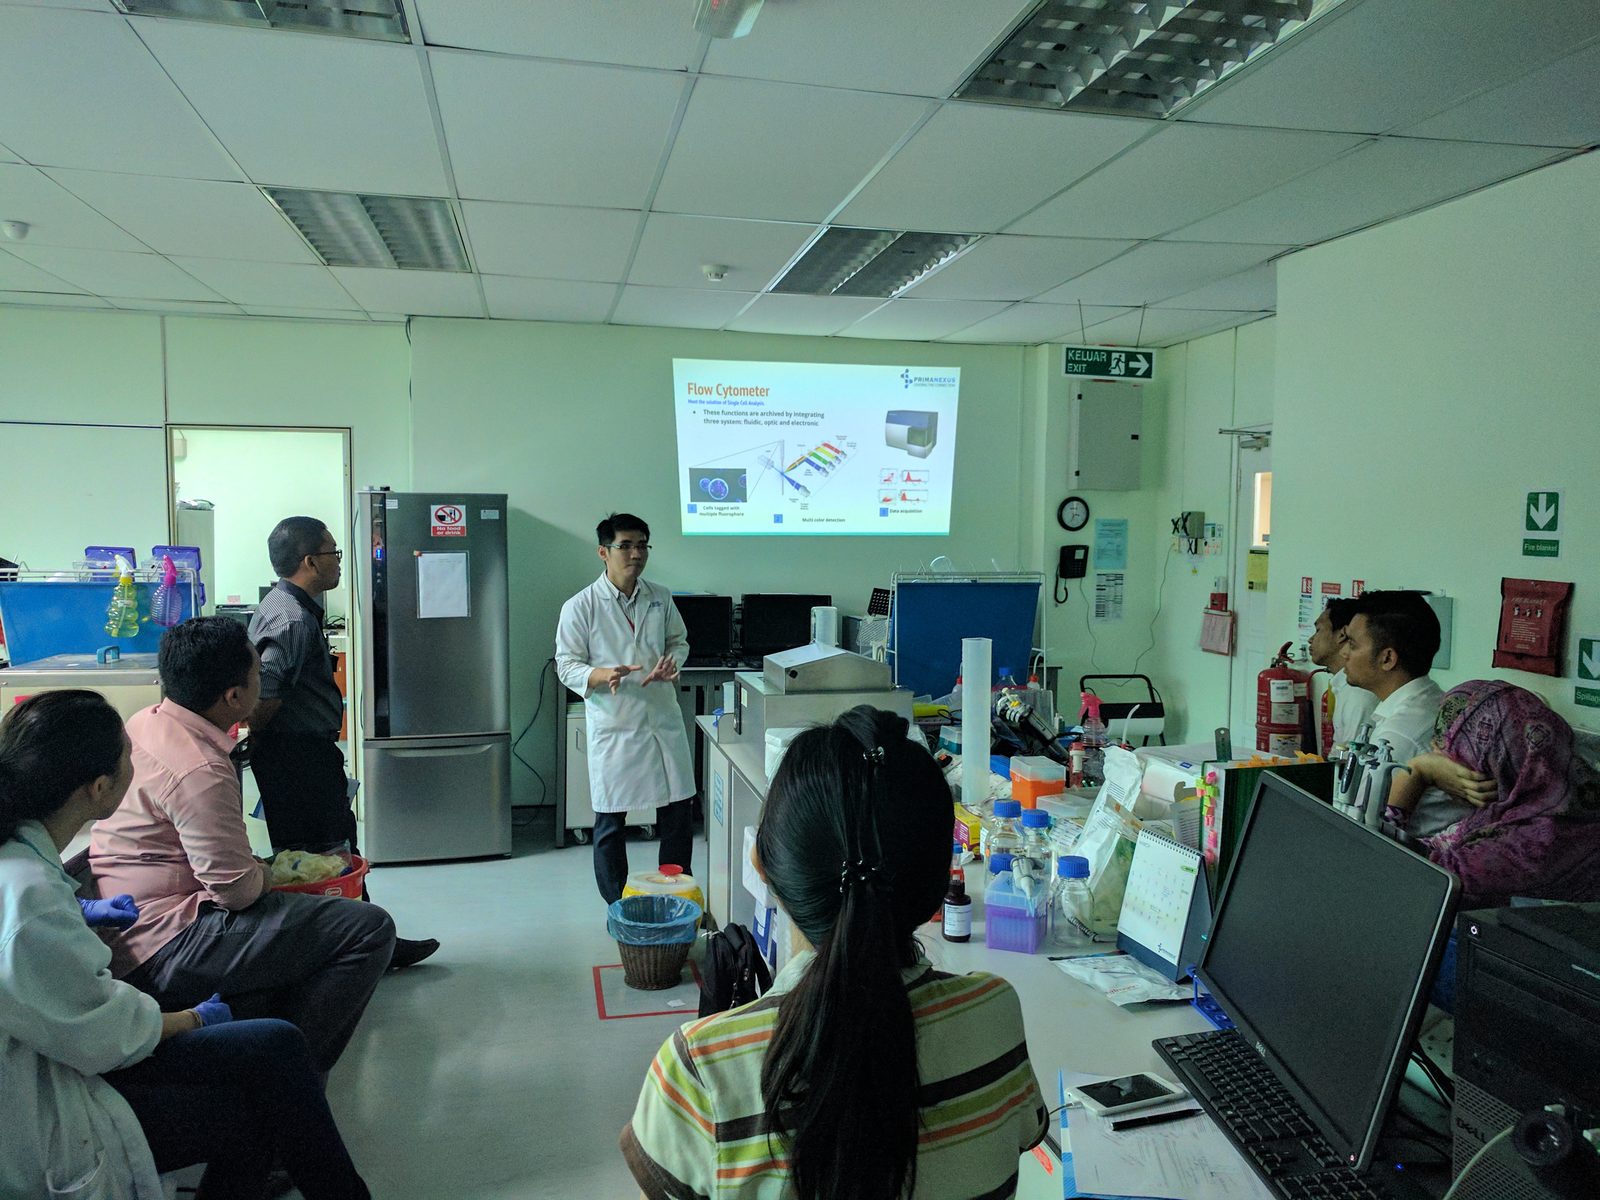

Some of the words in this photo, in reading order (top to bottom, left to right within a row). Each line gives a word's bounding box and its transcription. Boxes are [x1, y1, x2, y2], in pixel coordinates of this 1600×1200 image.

[1068, 350, 1107, 362] KELUAR
[1067, 363, 1087, 373] EXIT
[687, 382, 713, 396] Flow
[716, 383, 770, 399] Cytometer
[721, 409, 748, 417] functions
[785, 410, 793, 418] by
